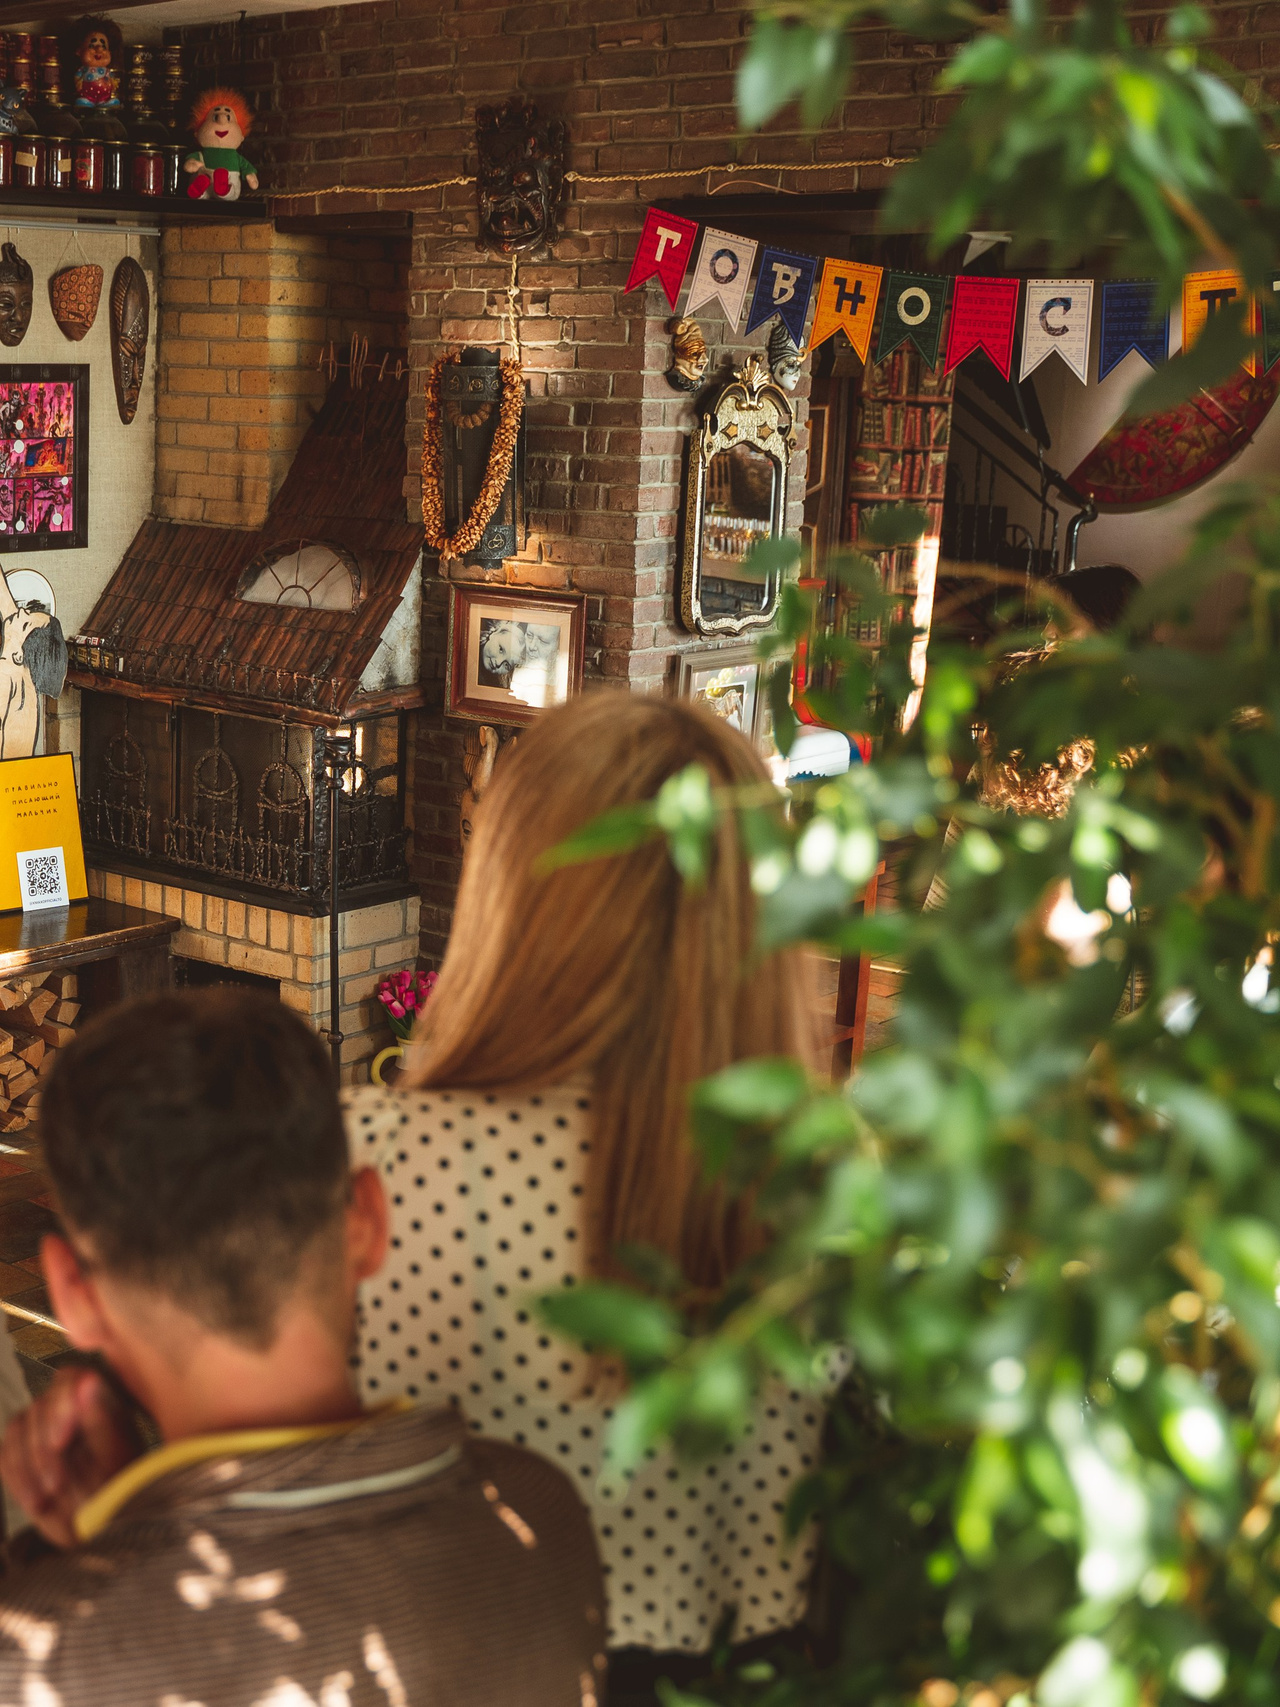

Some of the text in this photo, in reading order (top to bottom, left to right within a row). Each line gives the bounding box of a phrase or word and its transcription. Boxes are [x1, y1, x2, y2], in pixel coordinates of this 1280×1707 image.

[654, 225, 932, 327] ГОВНО
[4, 781, 59, 793] ПРАВИЛЬНО
[12, 793, 61, 805] ПИСАЮЩИЙ
[16, 808, 58, 818] МАЛЬЧИК
